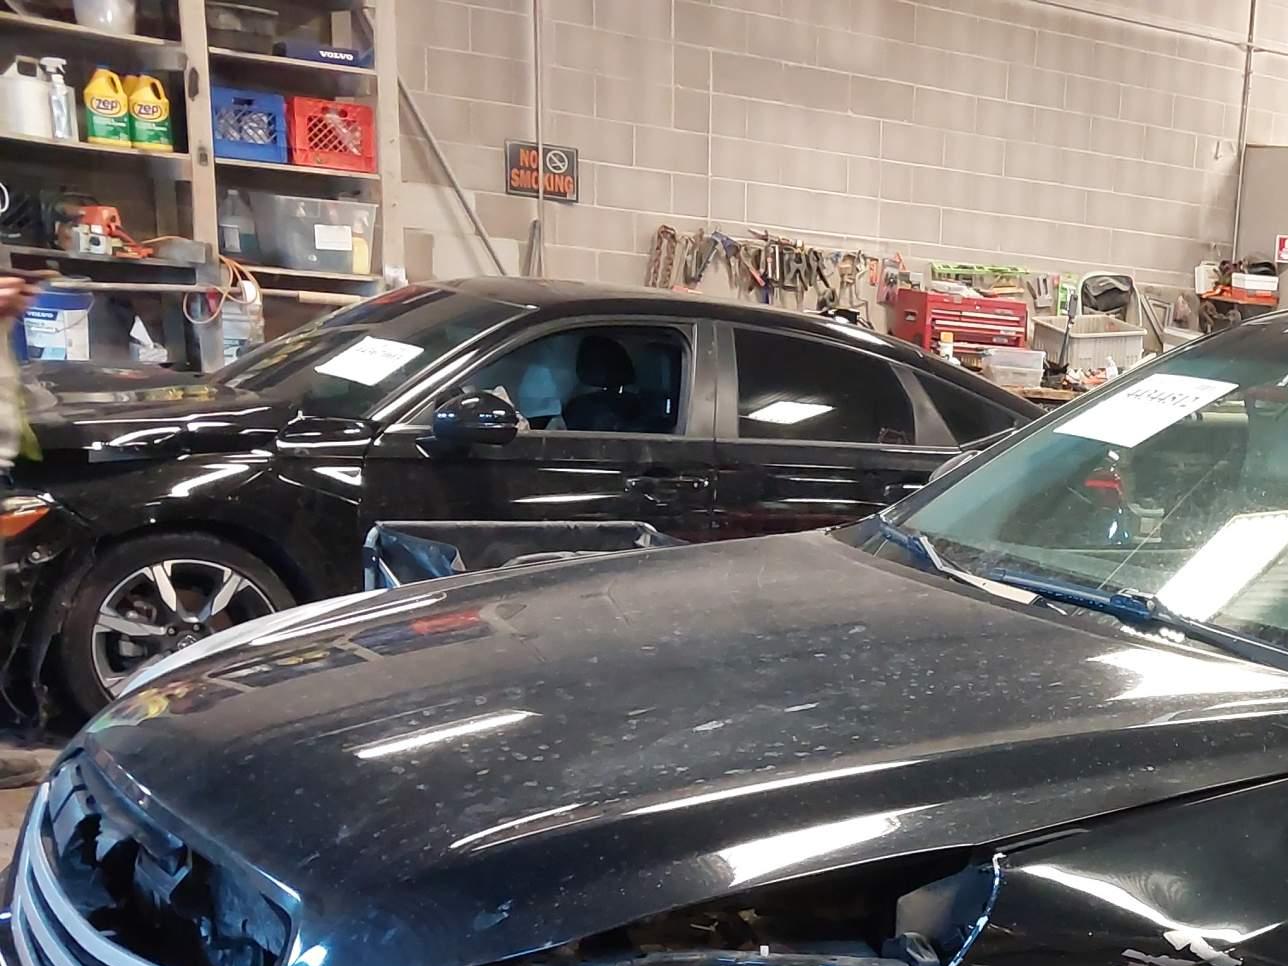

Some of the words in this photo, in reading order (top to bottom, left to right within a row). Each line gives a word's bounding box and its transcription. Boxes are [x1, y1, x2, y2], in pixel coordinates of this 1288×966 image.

[319, 50, 354, 61] VOLVO
[519, 149, 539, 169] NO
[511, 168, 574, 193] SMOKING
